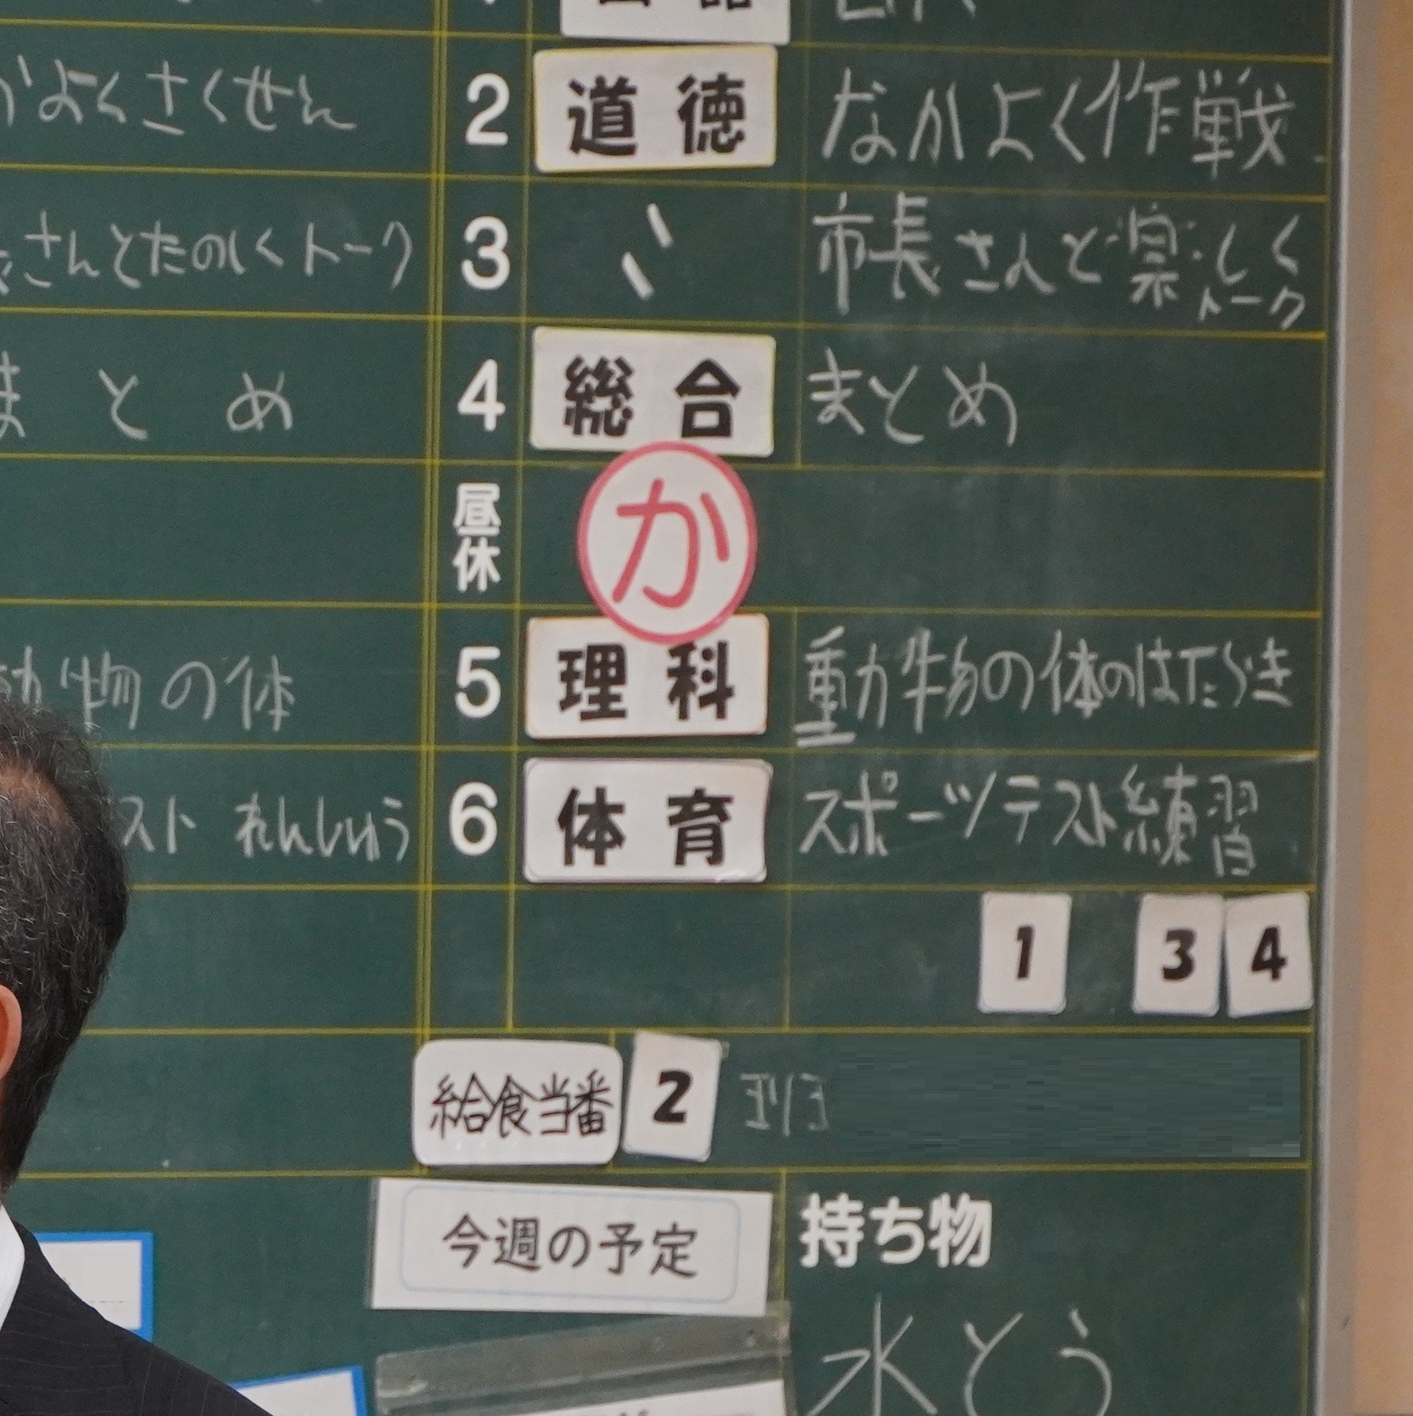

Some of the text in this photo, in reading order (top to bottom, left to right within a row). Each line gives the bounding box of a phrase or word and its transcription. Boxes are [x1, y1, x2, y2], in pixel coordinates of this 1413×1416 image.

[467, 74, 509, 144] 2
[569, 73, 744, 156] 道徳
[822, 60, 1295, 170] なかよく作戦
[463, 217, 509, 289] 3
[458, 360, 506, 431] 4
[564, 357, 740, 438] 総合
[807, 347, 1017, 445] まとめ
[454, 484, 500, 590] 昼休
[613, 477, 730, 609] か
[457, 647, 500, 717] 5
[558, 640, 734, 721] 理科
[451, 783, 496, 854] 6
[558, 787, 733, 866] 体育
[1017, 926, 1286, 980] 1 3 4
[431, 1070, 613, 1138] 給食当番
[654, 1070, 691, 1123] 2
[443, 1215, 697, 1277] 今週の予定
[802, 1194, 991, 1266] 持ち物
